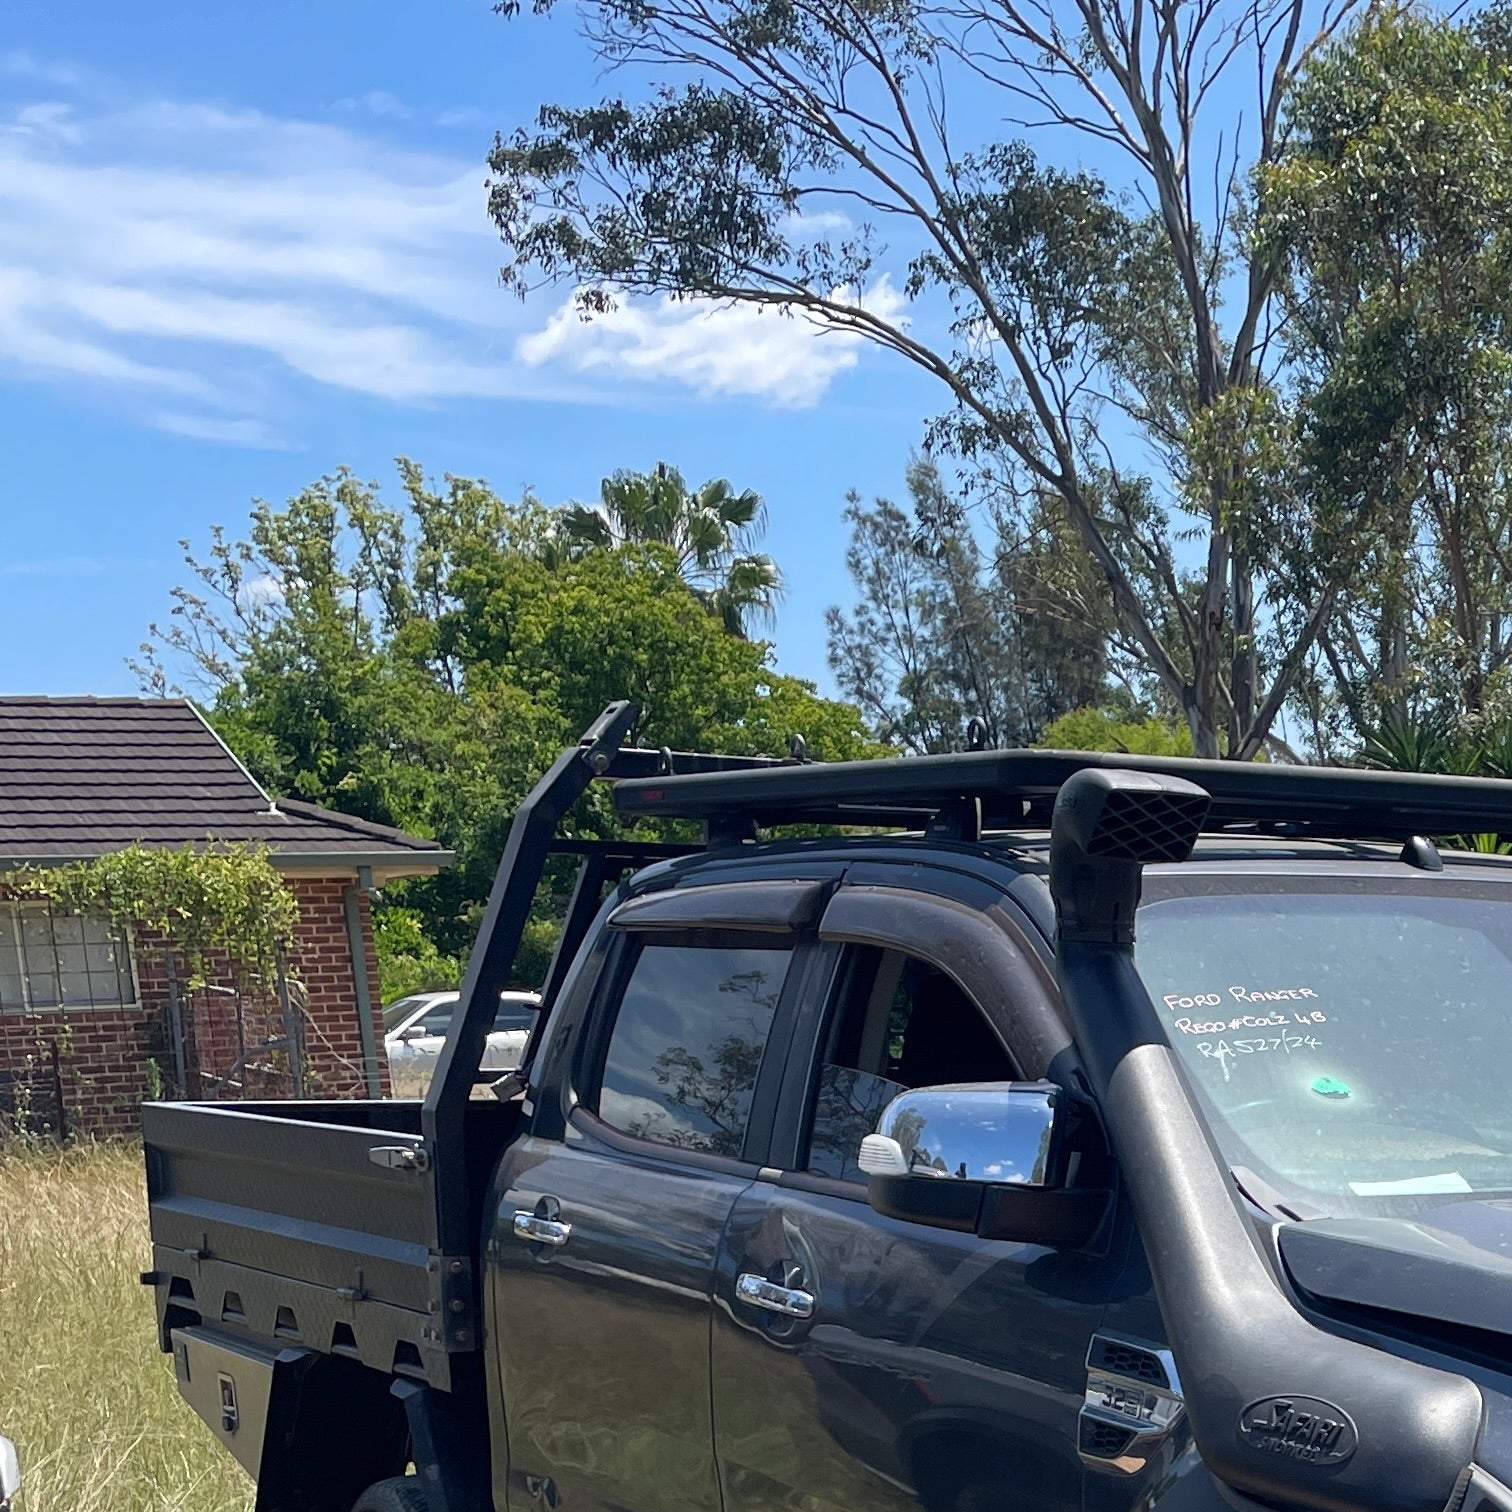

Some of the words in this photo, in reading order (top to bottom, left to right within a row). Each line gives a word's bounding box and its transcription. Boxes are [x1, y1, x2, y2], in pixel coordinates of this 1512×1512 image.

[1163, 993, 1221, 1011] FORD
[1229, 986, 1319, 1004] RANGER
[1252, 1398, 1346, 1454] SAFARI
